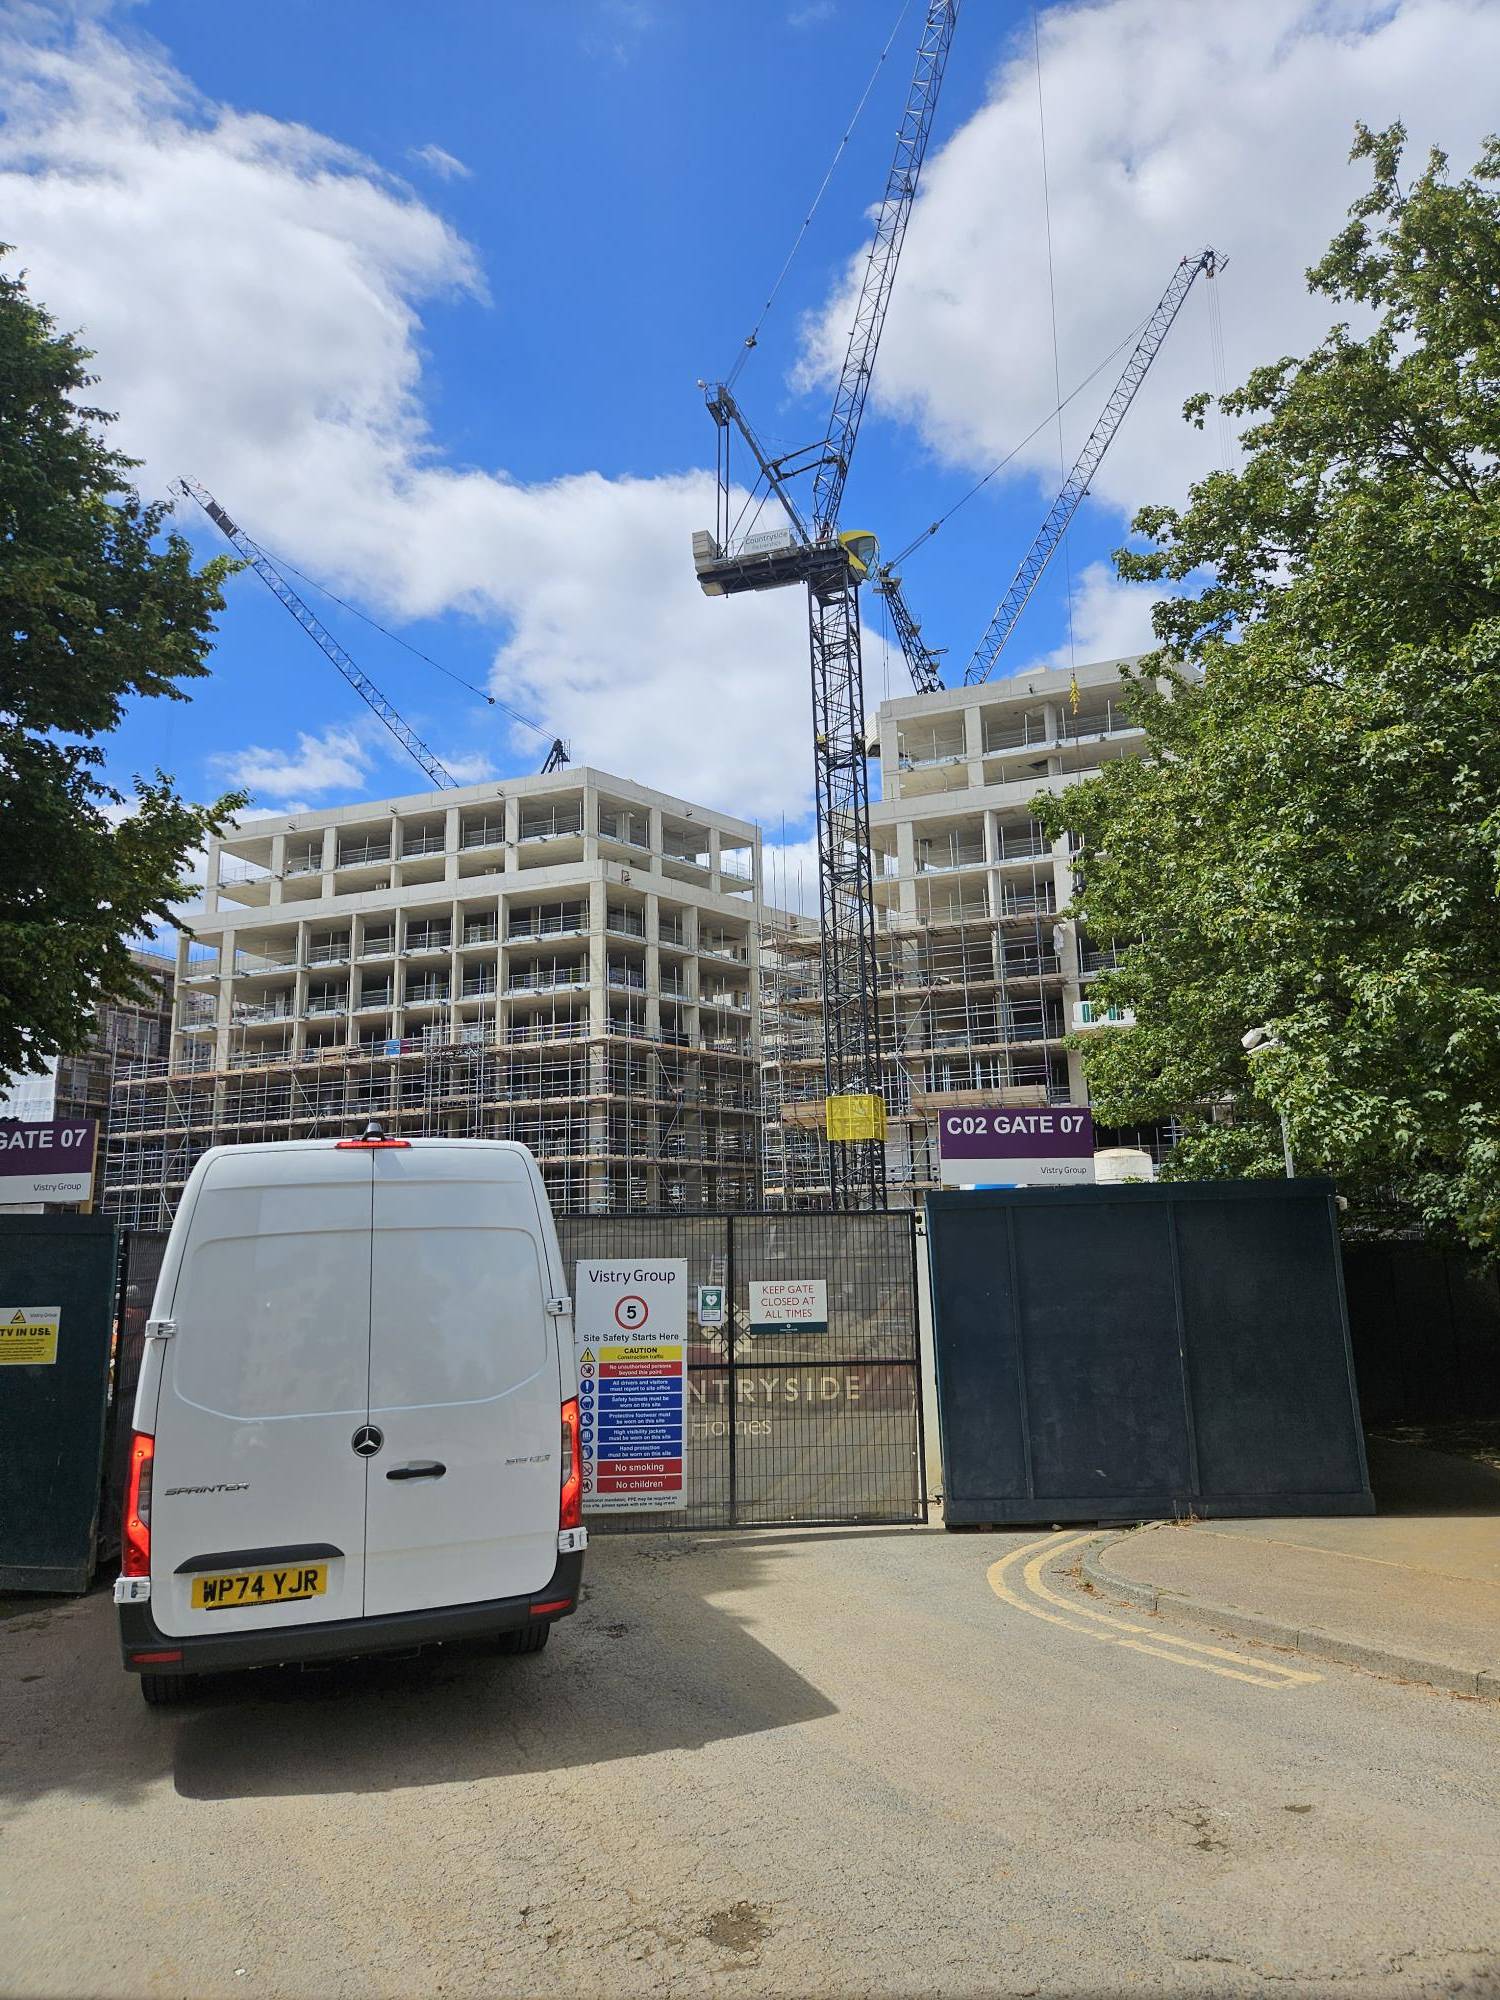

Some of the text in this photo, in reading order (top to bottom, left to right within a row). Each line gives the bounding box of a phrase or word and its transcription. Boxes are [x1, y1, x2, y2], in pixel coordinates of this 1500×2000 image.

[947, 1116, 1084, 1134] C02 GATE 07
[60, 1128, 88, 1148] 07
[1040, 1166, 1087, 1175] Vistry Group
[33, 1182, 82, 1192] Vistry Group
[588, 1269, 676, 1285] Vistry Group
[762, 1284, 814, 1294] KEEP GATE
[760, 1296, 816, 1306] CLOSED AT
[626, 1306, 636, 1319] 5
[765, 1309, 812, 1318] ALL TIMES
[16, 1328, 27, 1336] IN
[30, 1328, 52, 1336] USE
[584, 1332, 679, 1342] Site Safety Starts Here
[691, 1414, 772, 1437] Homes
[629, 1463, 664, 1472] smoking
[164, 1482, 249, 1496] SPRINTER
[204, 1570, 318, 1602] WP74 YJR
